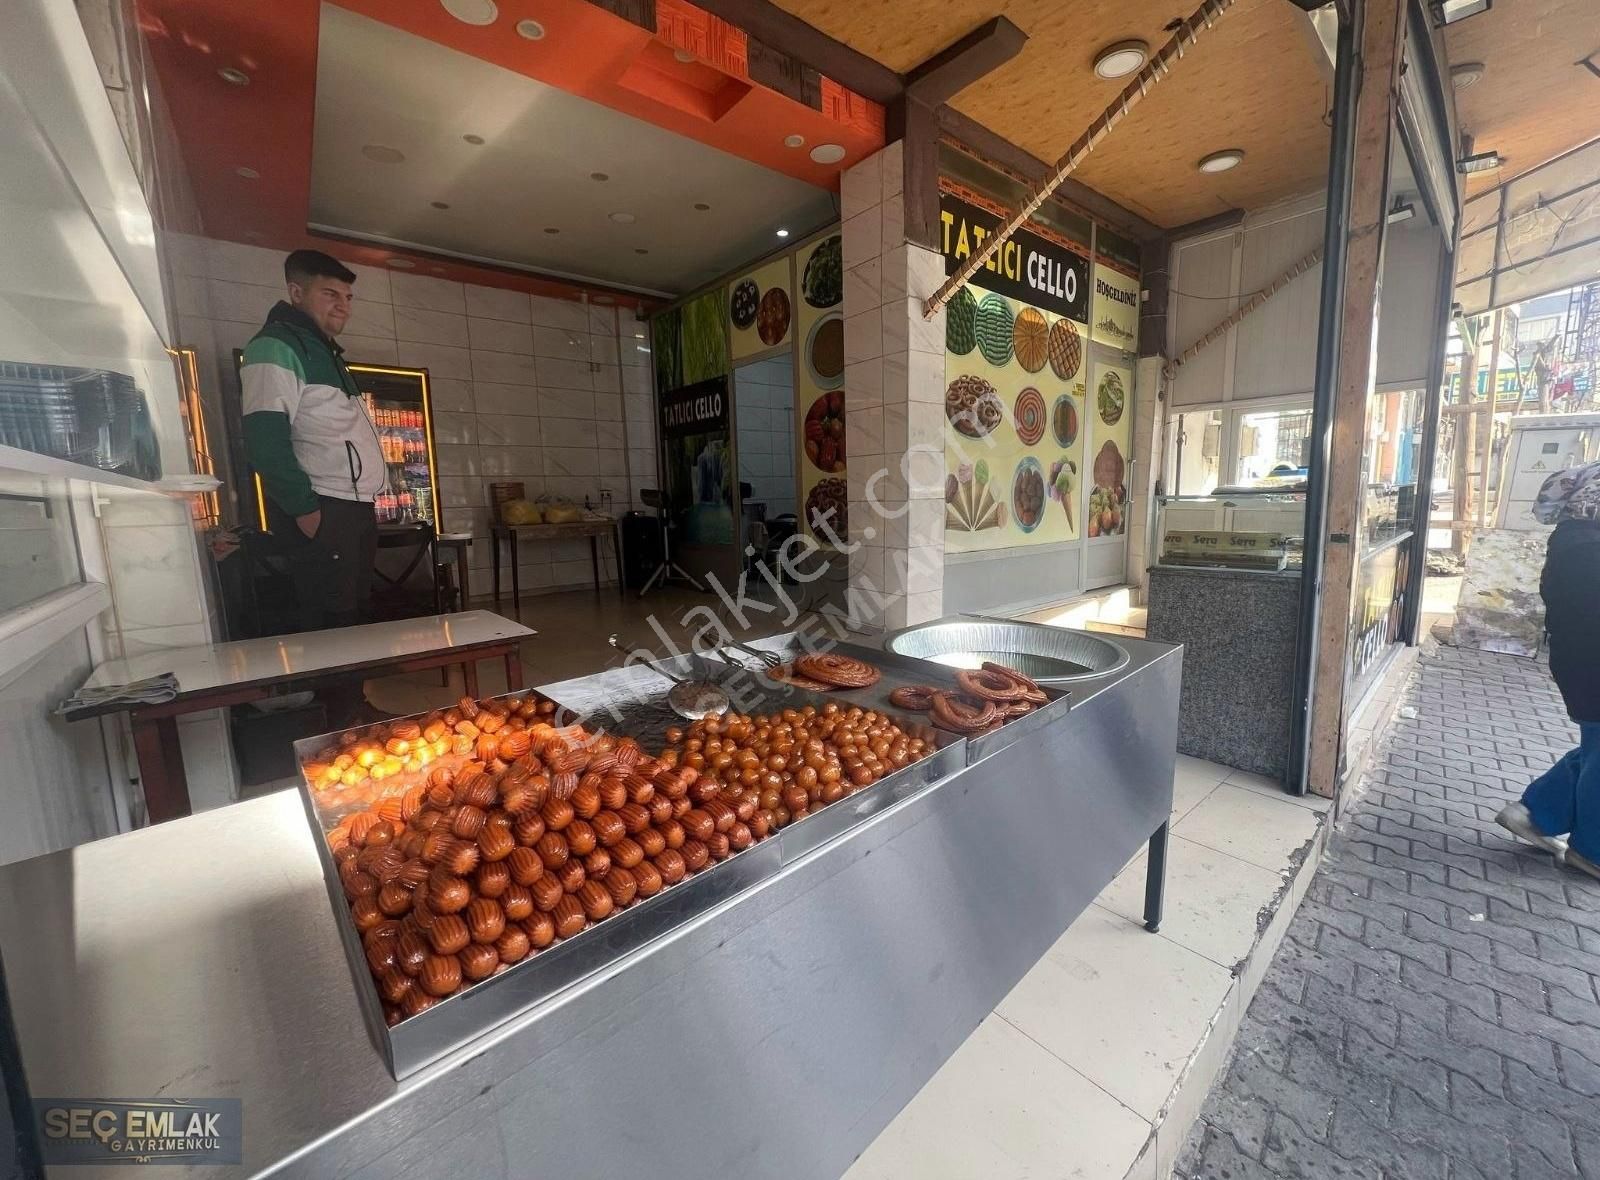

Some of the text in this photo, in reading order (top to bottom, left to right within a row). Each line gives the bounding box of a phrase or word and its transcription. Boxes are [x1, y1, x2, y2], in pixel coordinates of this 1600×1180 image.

[1027, 250, 1077, 303] CELLO
[664, 393, 722, 427] TATLICI CELLO
